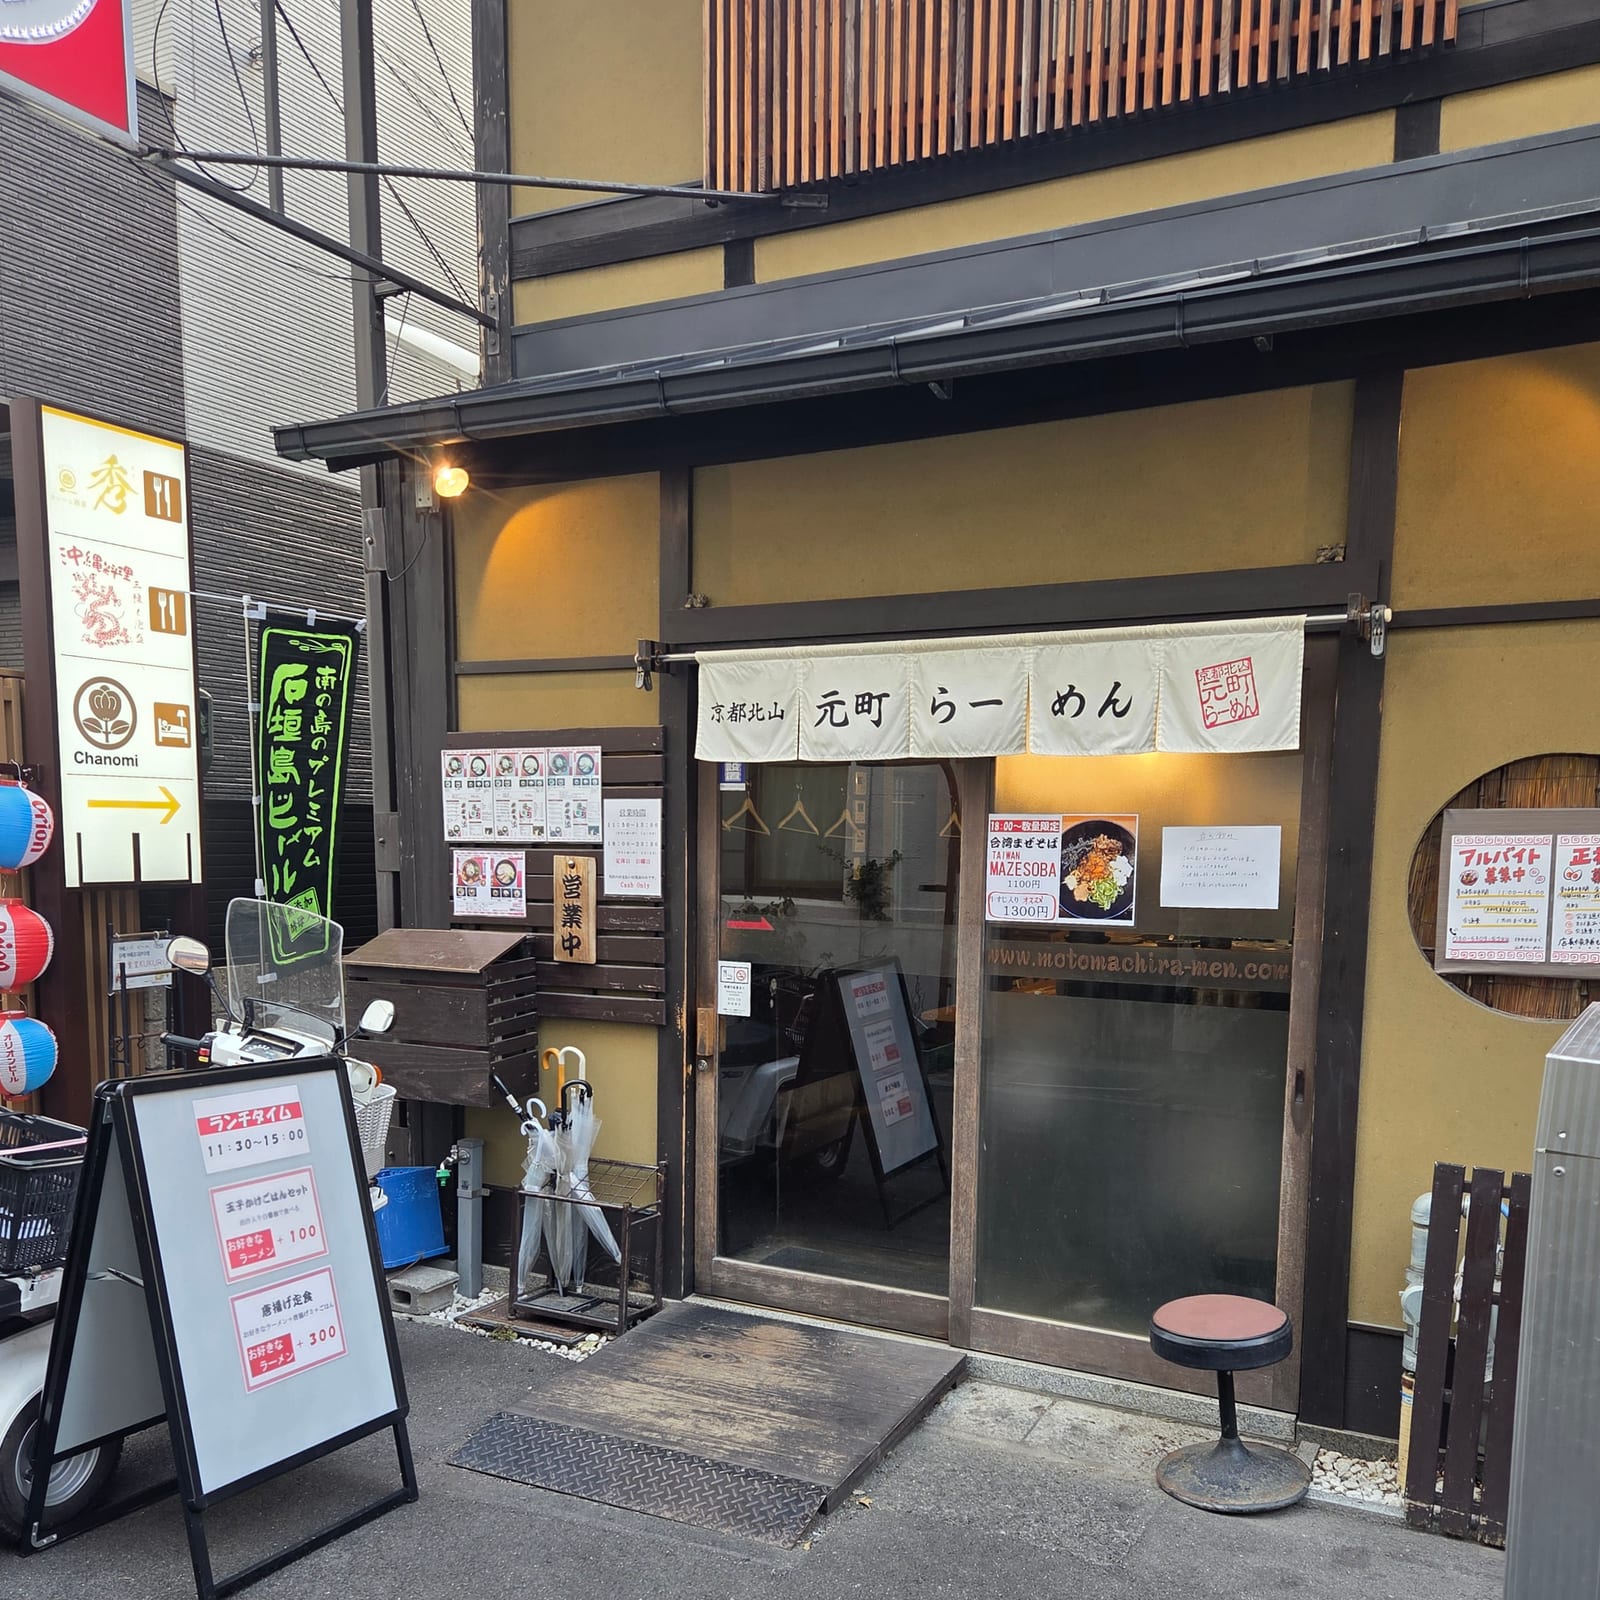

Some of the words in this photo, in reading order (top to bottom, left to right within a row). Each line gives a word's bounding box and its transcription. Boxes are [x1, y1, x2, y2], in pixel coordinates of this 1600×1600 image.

[1202, 674, 1250, 704] 元町
[710, 701, 786, 723] 京都北山
[813, 689, 890, 729] 元町
[1205, 696, 1258, 726] らーめん
[74, 751, 139, 767] Chanomi
[303, 666, 337, 867] 南の島のプレミアム
[266, 663, 309, 894] 石垣島ビール
[990, 837, 1059, 849] 台湾まぜそば
[992, 851, 1021, 860] TAIWAN
[1459, 847, 1541, 867] アルバイト
[989, 861, 1057, 877] MAZESOBA
[1484, 866, 1526, 885] 募集中
[1007, 880, 1041, 889] 1100円
[560, 874, 583, 957] 営業中
[1003, 905, 1049, 918] 1300円
[3, 1034, 19, 1083] オリオンビール
[208, 1105, 293, 1132] ランチタイム
[225, 1185, 309, 1214] 玉子かけごはんセット
[226, 1233, 264, 1252] お好きな
[289, 1224, 316, 1243] 100
[239, 1247, 275, 1265] ラーメン
[261, 1290, 313, 1318] 唐揚げ定食
[308, 1325, 336, 1346] 300
[248, 1339, 284, 1361] お好きな
[259, 1351, 295, 1372] ラーメン
